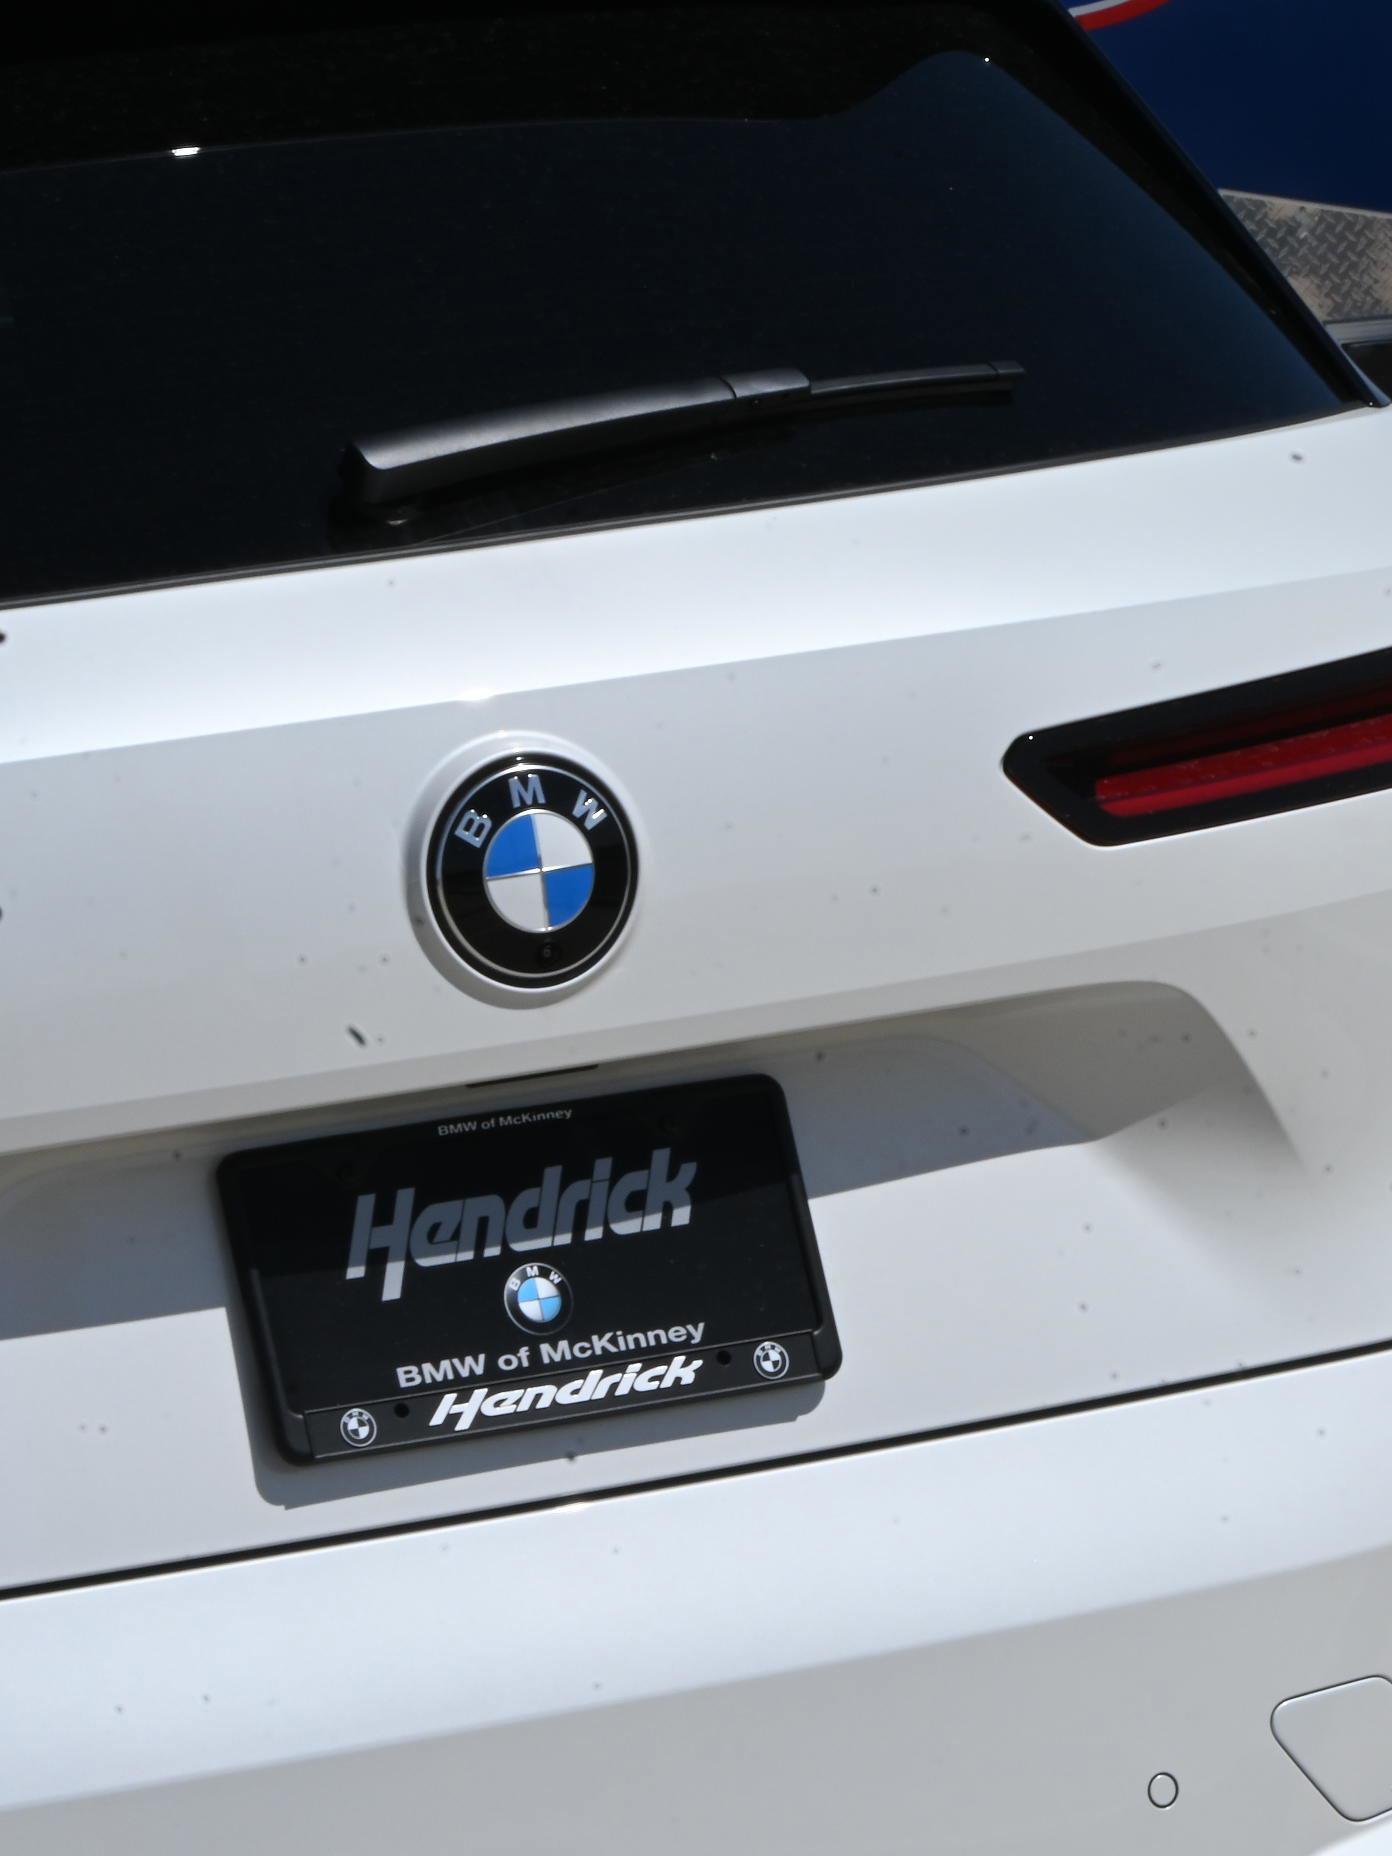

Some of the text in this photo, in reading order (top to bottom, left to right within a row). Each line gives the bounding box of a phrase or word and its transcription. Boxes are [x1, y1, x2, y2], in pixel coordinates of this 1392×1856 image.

[454, 773, 608, 849] BMW
[437, 1109, 572, 1137] BMW of McKinney
[345, 1147, 698, 1302] Hendrick
[509, 1265, 563, 1291] BMW
[396, 1322, 705, 1389] BMW of McKinney
[428, 1355, 704, 1432] Hendrick
